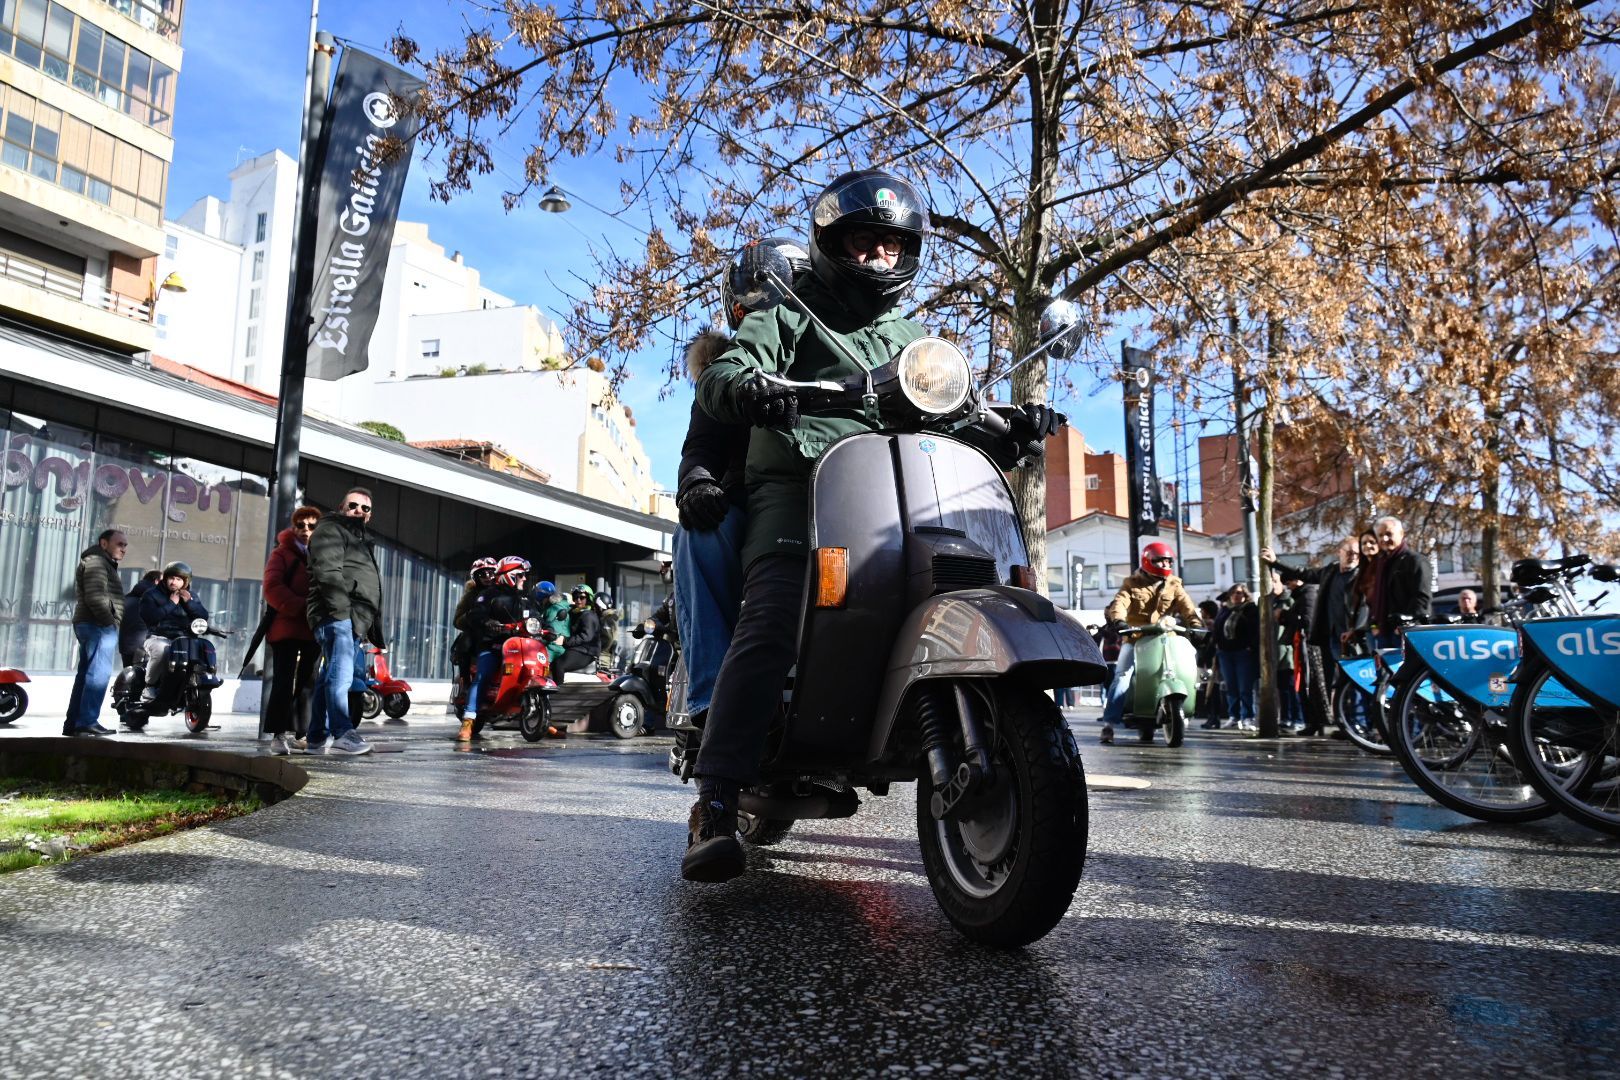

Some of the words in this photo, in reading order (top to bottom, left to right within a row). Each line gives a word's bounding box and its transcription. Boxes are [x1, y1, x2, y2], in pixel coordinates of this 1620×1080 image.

[315, 242, 365, 355] Estrella
[340, 133, 384, 236] Galicia
[1141, 456, 1156, 522] Estrella
[1433, 636, 1515, 660] alsa
